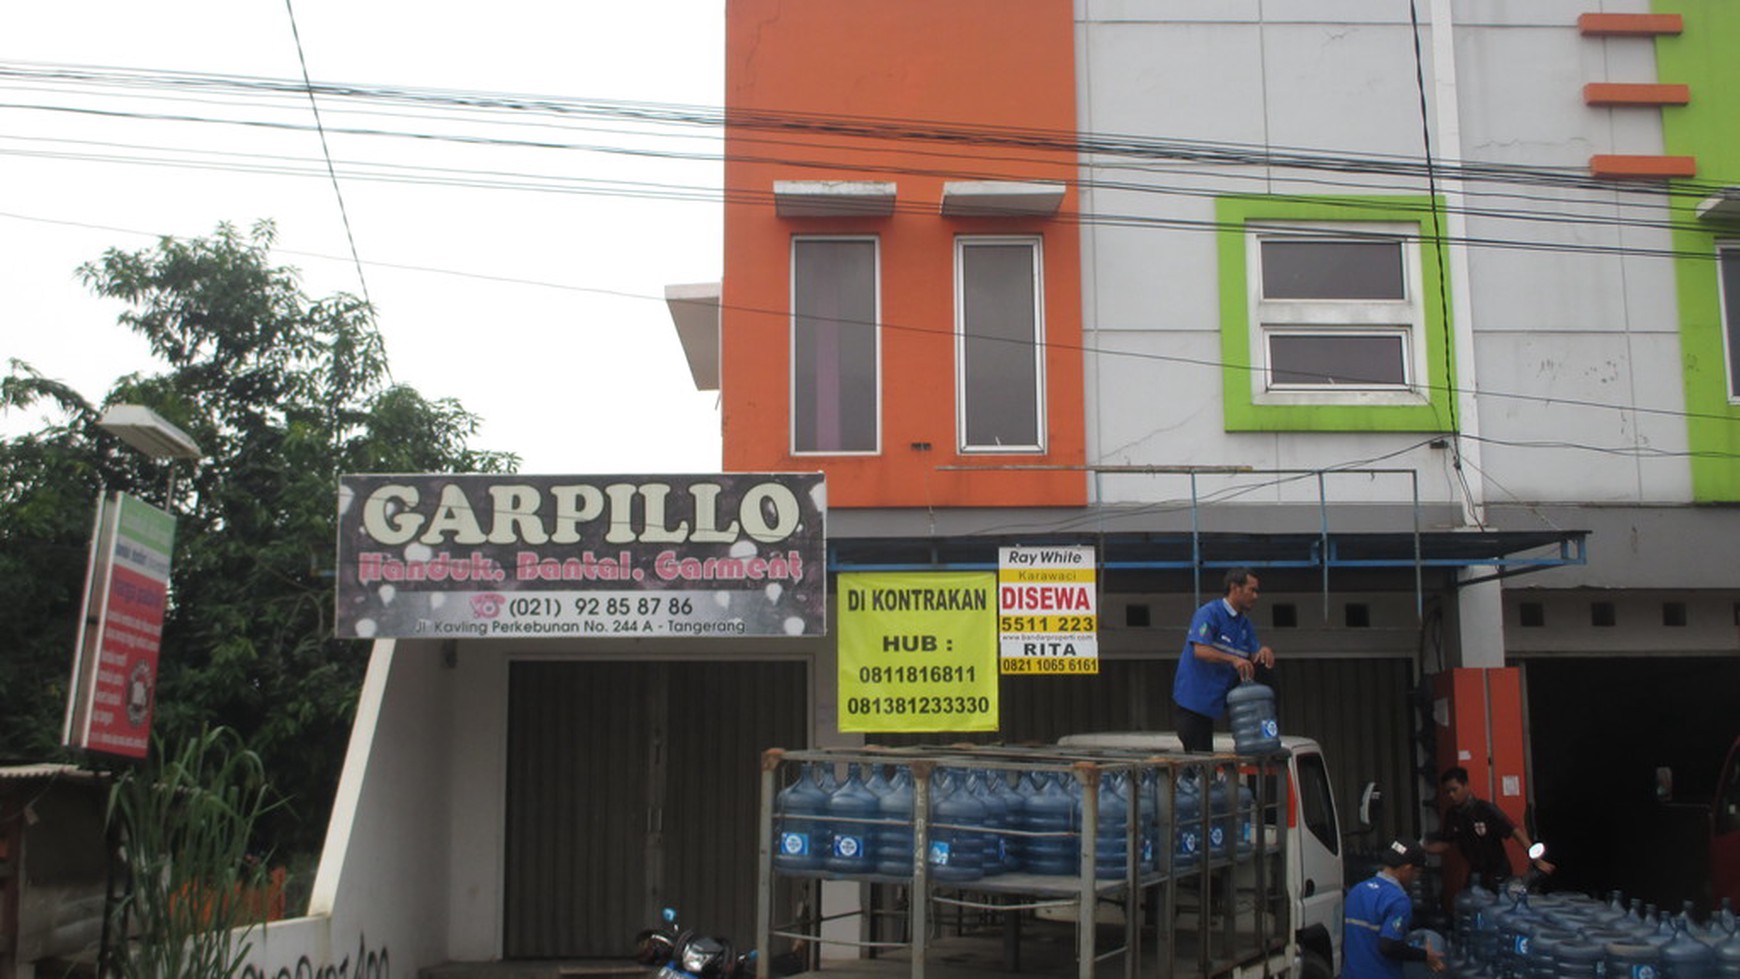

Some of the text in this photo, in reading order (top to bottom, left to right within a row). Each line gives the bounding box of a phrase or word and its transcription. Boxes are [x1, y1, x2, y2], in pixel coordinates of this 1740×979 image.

[363, 483, 800, 546] GARPILLO
[654, 550, 804, 582] Garment
[1008, 550, 1082, 565] Ray White
[1018, 570, 1077, 581] Karawaci
[509, 597, 693, 617] (021) 92 85 87 86
[847, 588, 988, 612] DI KONTRAKAN
[1001, 586, 1091, 611] DISEWA
[434, 620, 488, 636] Kavling
[492, 620, 580, 634] Perkebunan
[584, 620, 609, 633] No.
[613, 620, 639, 633] 244
[642, 620, 654, 633] A
[668, 619, 746, 636] Tangerang
[1001, 616, 1094, 632] 5511 223
[883, 635, 954, 652] HUB :
[1023, 643, 1077, 656] RITA
[859, 665, 976, 684] 0811816811
[1002, 659, 1097, 672] 0821 1065 6161
[847, 696, 990, 715] 081381233330
